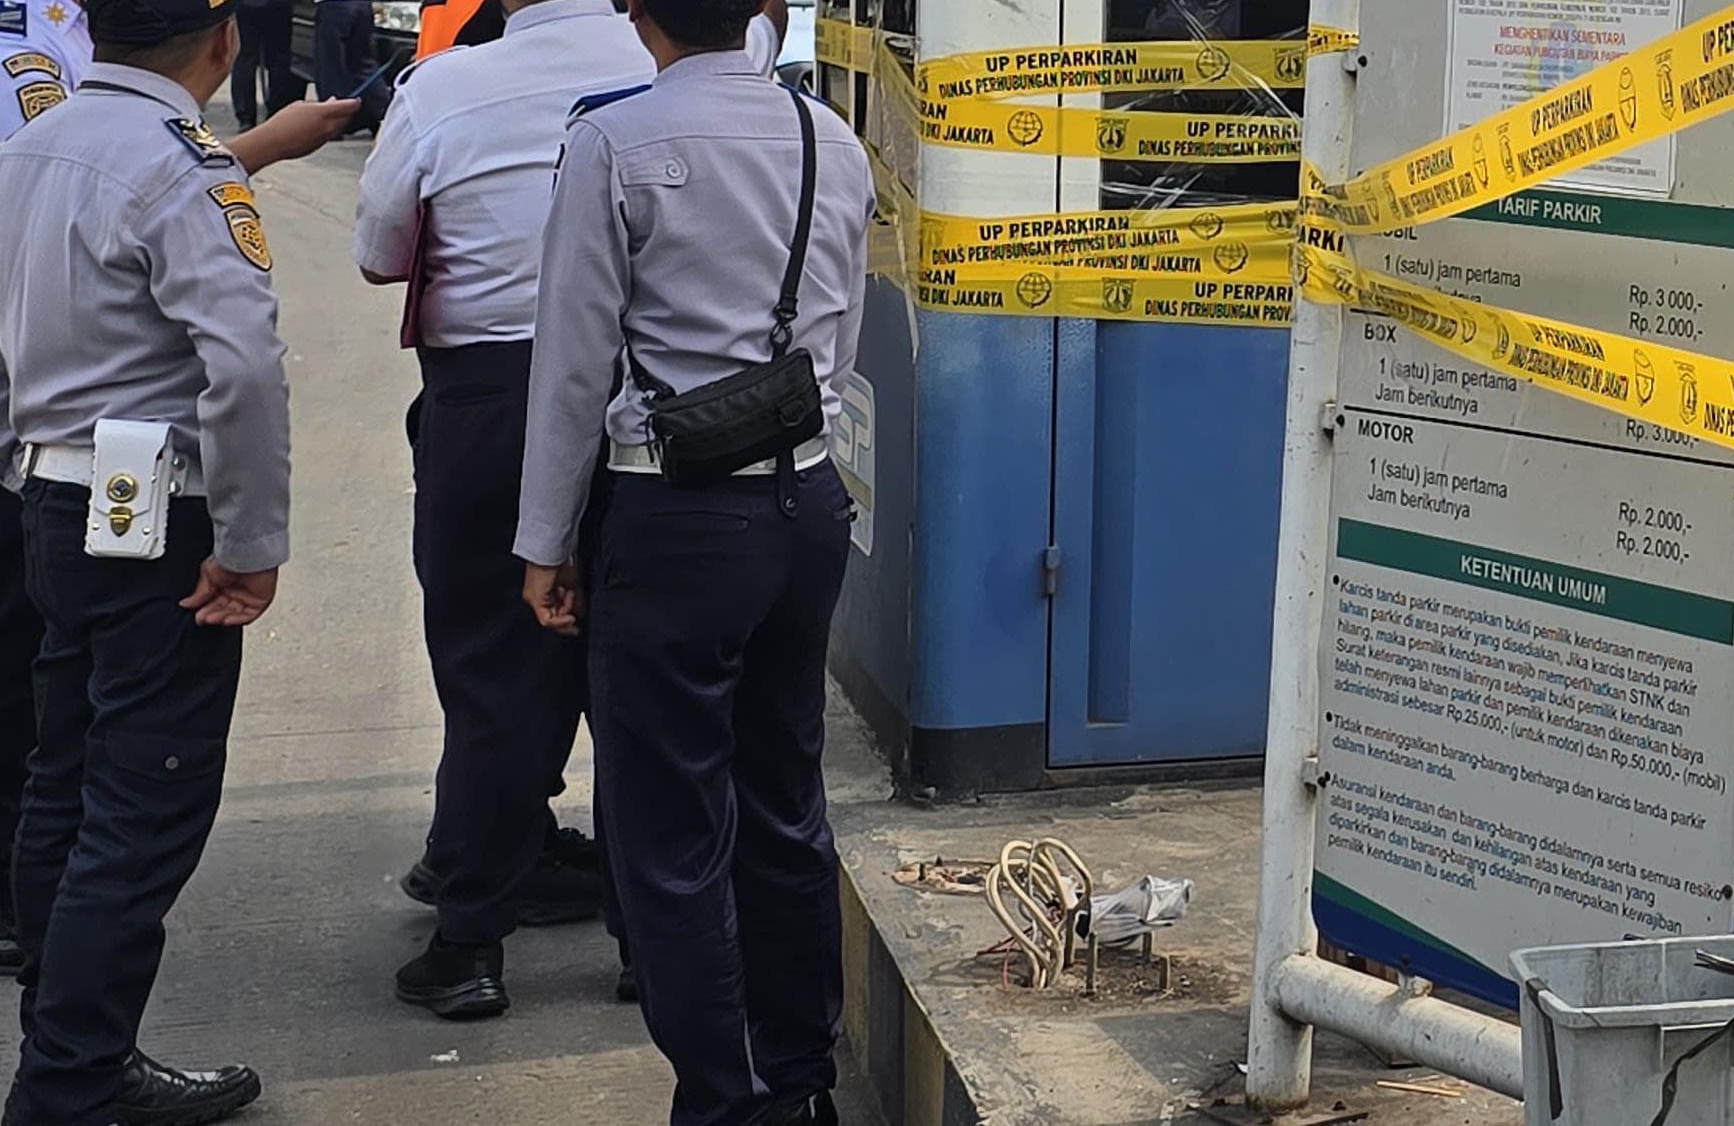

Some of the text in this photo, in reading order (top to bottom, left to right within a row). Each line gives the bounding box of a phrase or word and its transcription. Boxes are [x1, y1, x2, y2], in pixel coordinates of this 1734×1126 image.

[1702, 30, 1715, 62] UP
[986, 49, 1137, 72] UP PERPARKIRAN
[939, 68, 1184, 98] DINAS PERHUBUNGAN PROVINSI DKI JAKARTA
[925, 126, 993, 145] DKI JAKARTA
[1187, 121, 1300, 139] UP PERPARKI
[1139, 139, 1170, 156] DINAS
[1258, 139, 1301, 156] PROVINS
[1497, 194, 1601, 224] TARIF PARKIR
[980, 216, 1129, 241] UP PERPARKIRAN
[1107, 233, 1127, 249] DKI
[1131, 230, 1179, 247] JAKARTA
[1130, 254, 1201, 273] DKI JAKARTA
[1384, 253, 1520, 287] 1 (satu) jam pertama
[931, 288, 1003, 308] DKI JAKARTA
[1195, 281, 1293, 301] UP PERPAR
[1629, 284, 1652, 309] Rp.
[1145, 299, 1175, 317] DINAS
[1263, 305, 1293, 322] PROV
[1364, 322, 1396, 342] BOX
[1629, 311, 1703, 342] Rp. 2.000,-
[1379, 357, 1516, 391] 1 (satu) jam pertama
[1374, 382, 1477, 416] Jam berikutnya
[1358, 418, 1413, 444] MOTOR
[1626, 419, 1648, 442] Rp.
[1370, 457, 1507, 498] 1 (satu) jam pertama
[1367, 483, 1470, 520] Jam berikutnya
[1618, 501, 1692, 535] Rp. 2.000,-
[1616, 530, 1689, 564] Rp. 2.000,-
[1460, 554, 1605, 604] KETENTUAN UMUM
[1629, 688, 1689, 717] STNK dan
[1586, 741, 1607, 760] dan
[1571, 780, 1593, 800] dan
